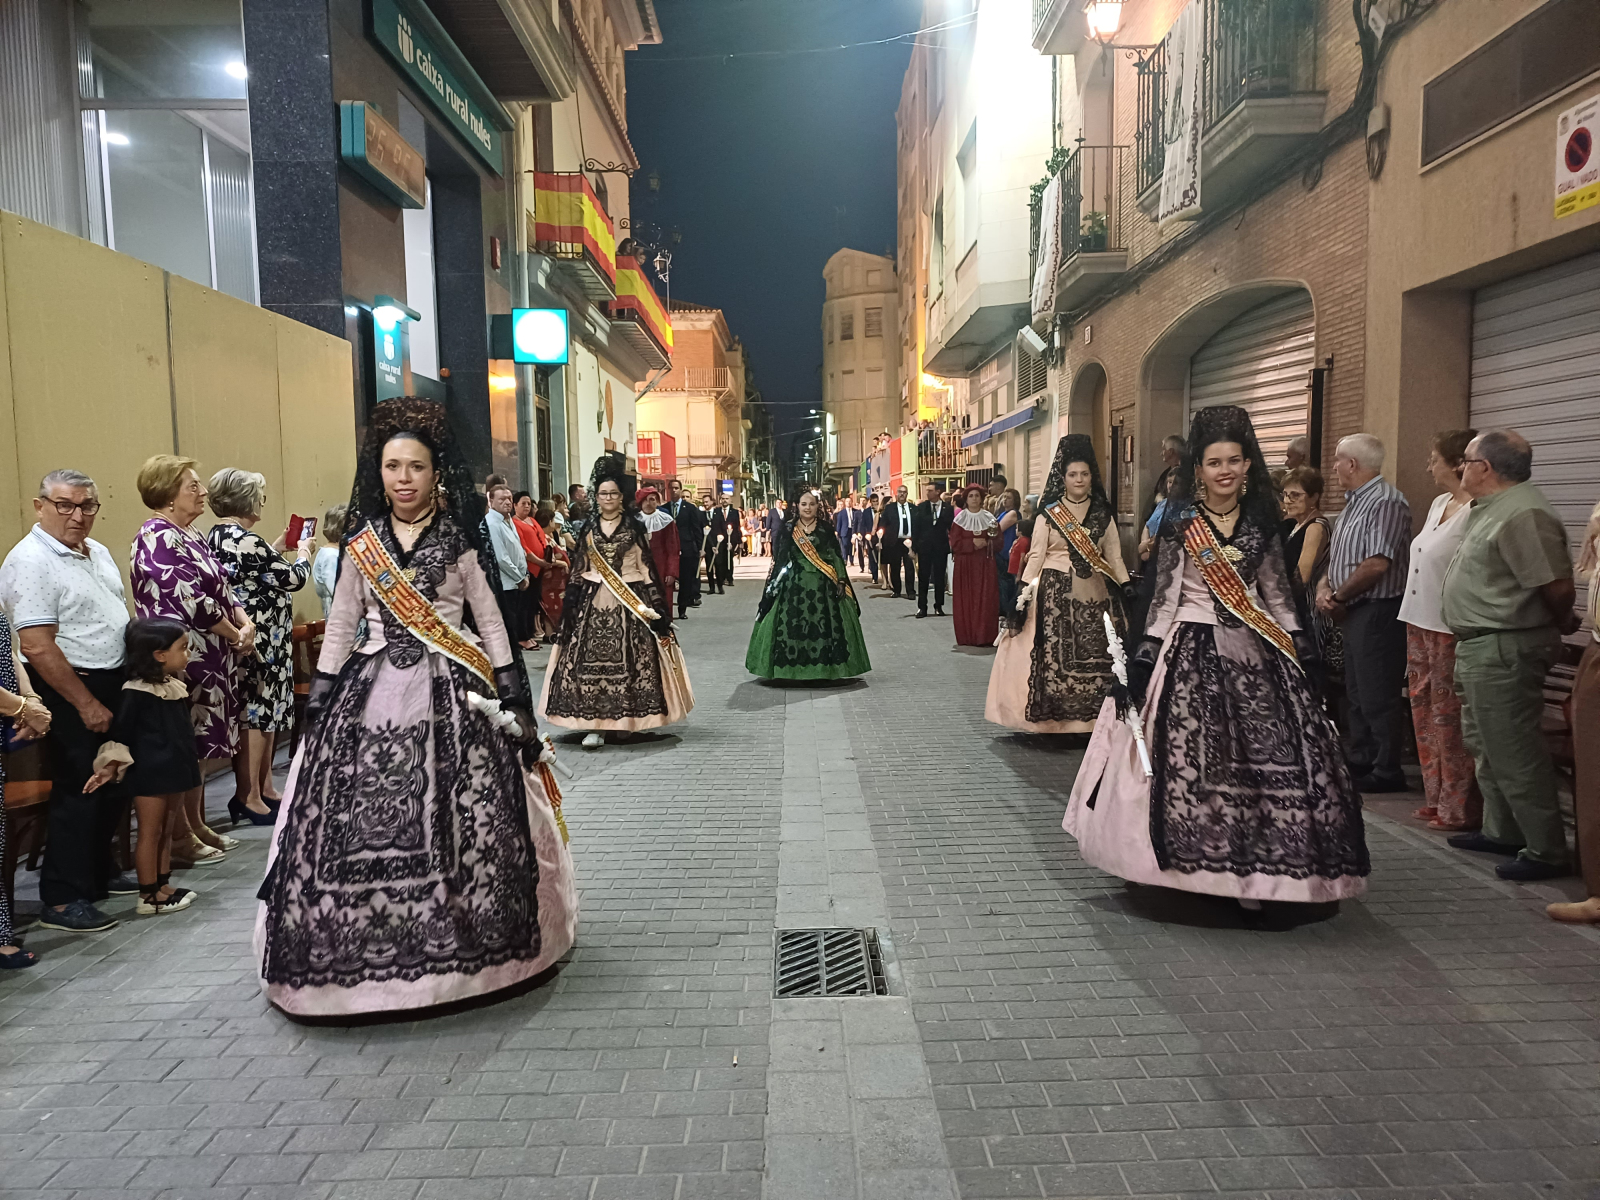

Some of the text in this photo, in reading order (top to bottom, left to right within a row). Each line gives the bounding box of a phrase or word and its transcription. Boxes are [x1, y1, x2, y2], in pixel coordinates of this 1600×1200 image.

[416, 48, 491, 151] caixa rural nules
[378, 360, 391, 373] caixa
